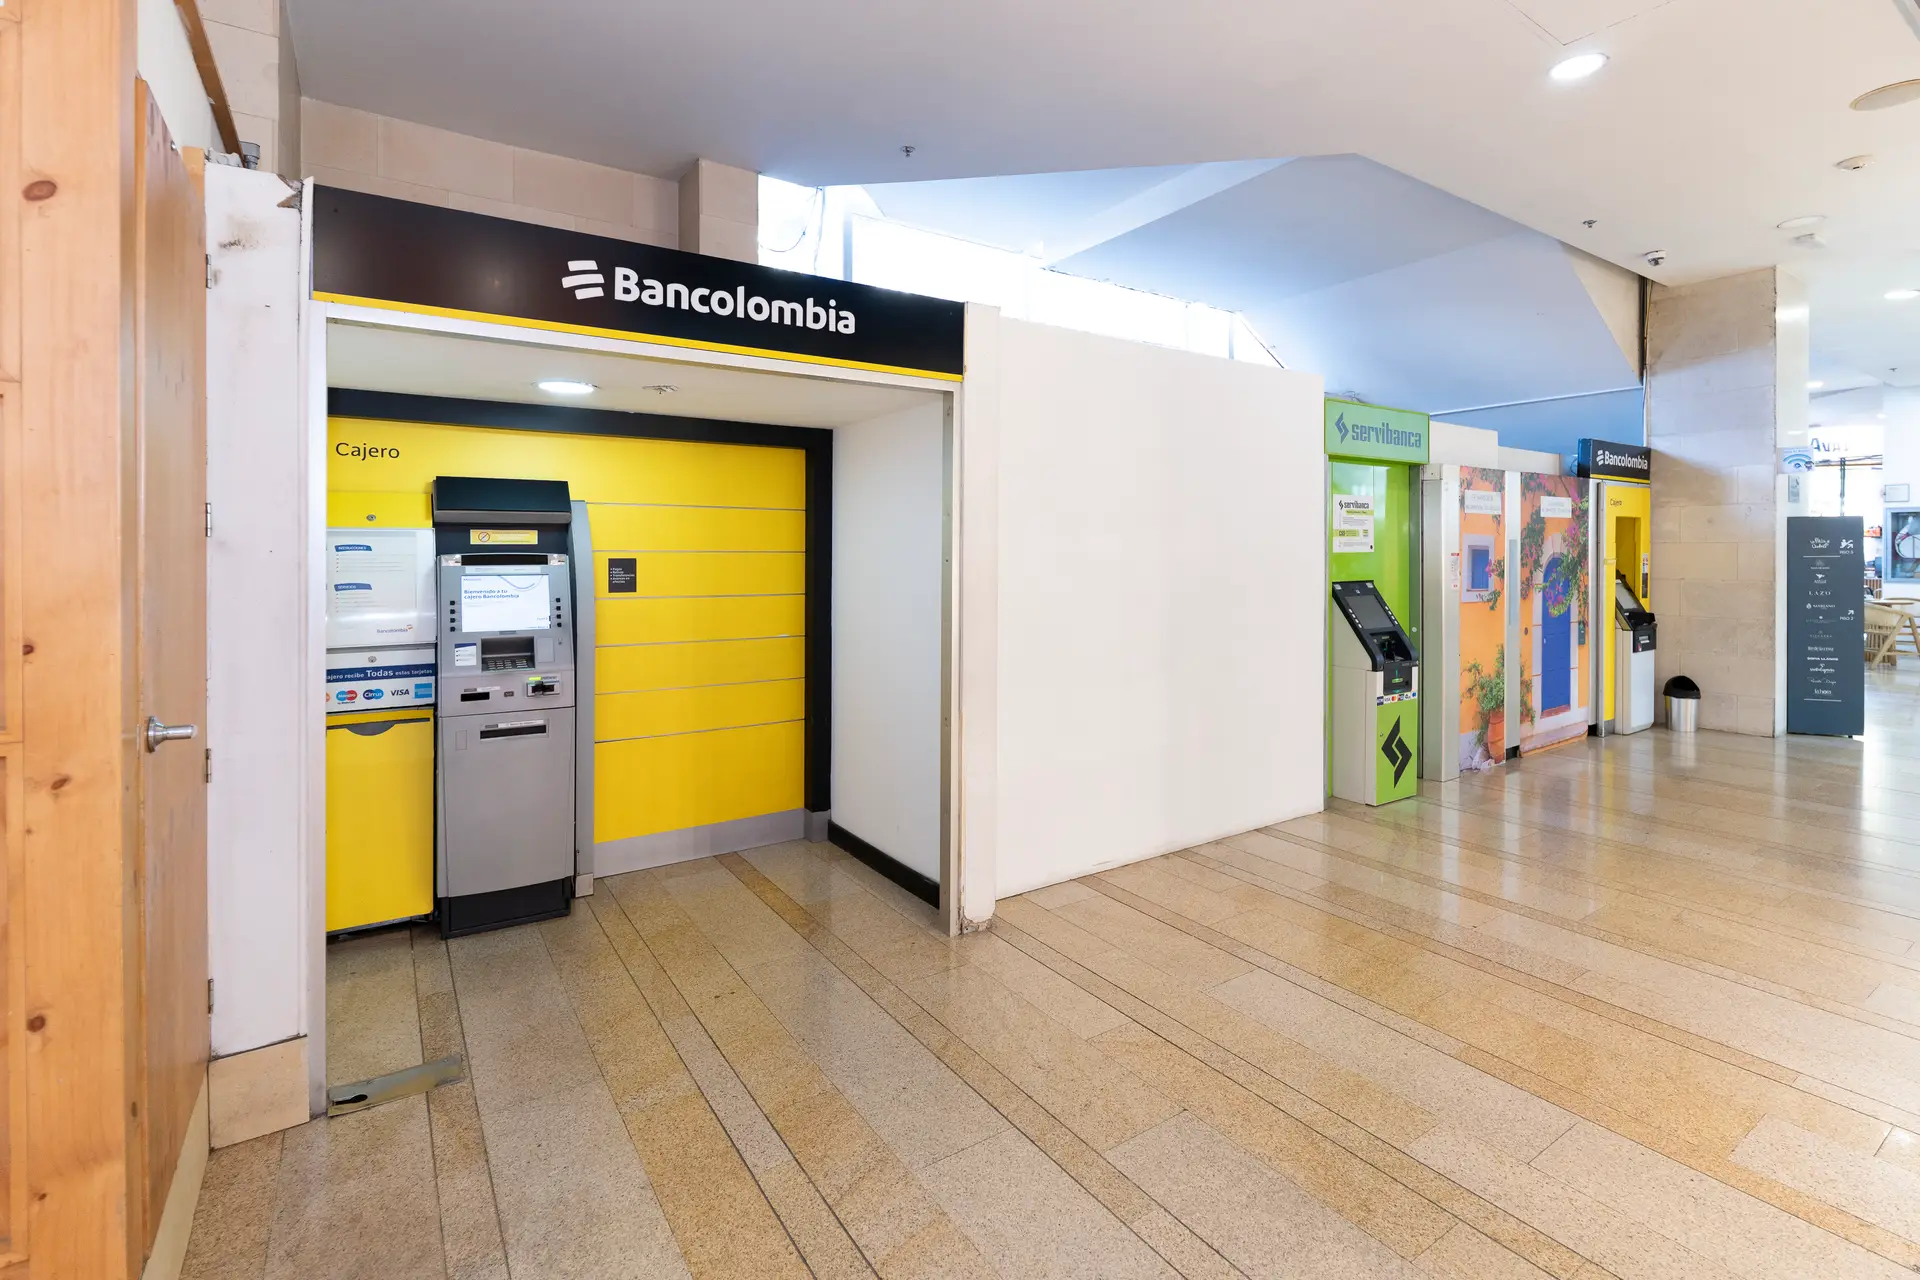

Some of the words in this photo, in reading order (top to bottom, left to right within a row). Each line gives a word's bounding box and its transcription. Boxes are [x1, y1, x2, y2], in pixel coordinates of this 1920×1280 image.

[614, 266, 856, 335] Bancolombia
[1351, 422, 1422, 448] servibanca
[335, 442, 400, 461] Cajero
[1604, 451, 1648, 470] Bancolombia
[1343, 501, 1370, 509] servibanca
[366, 669, 393, 677] Todas
